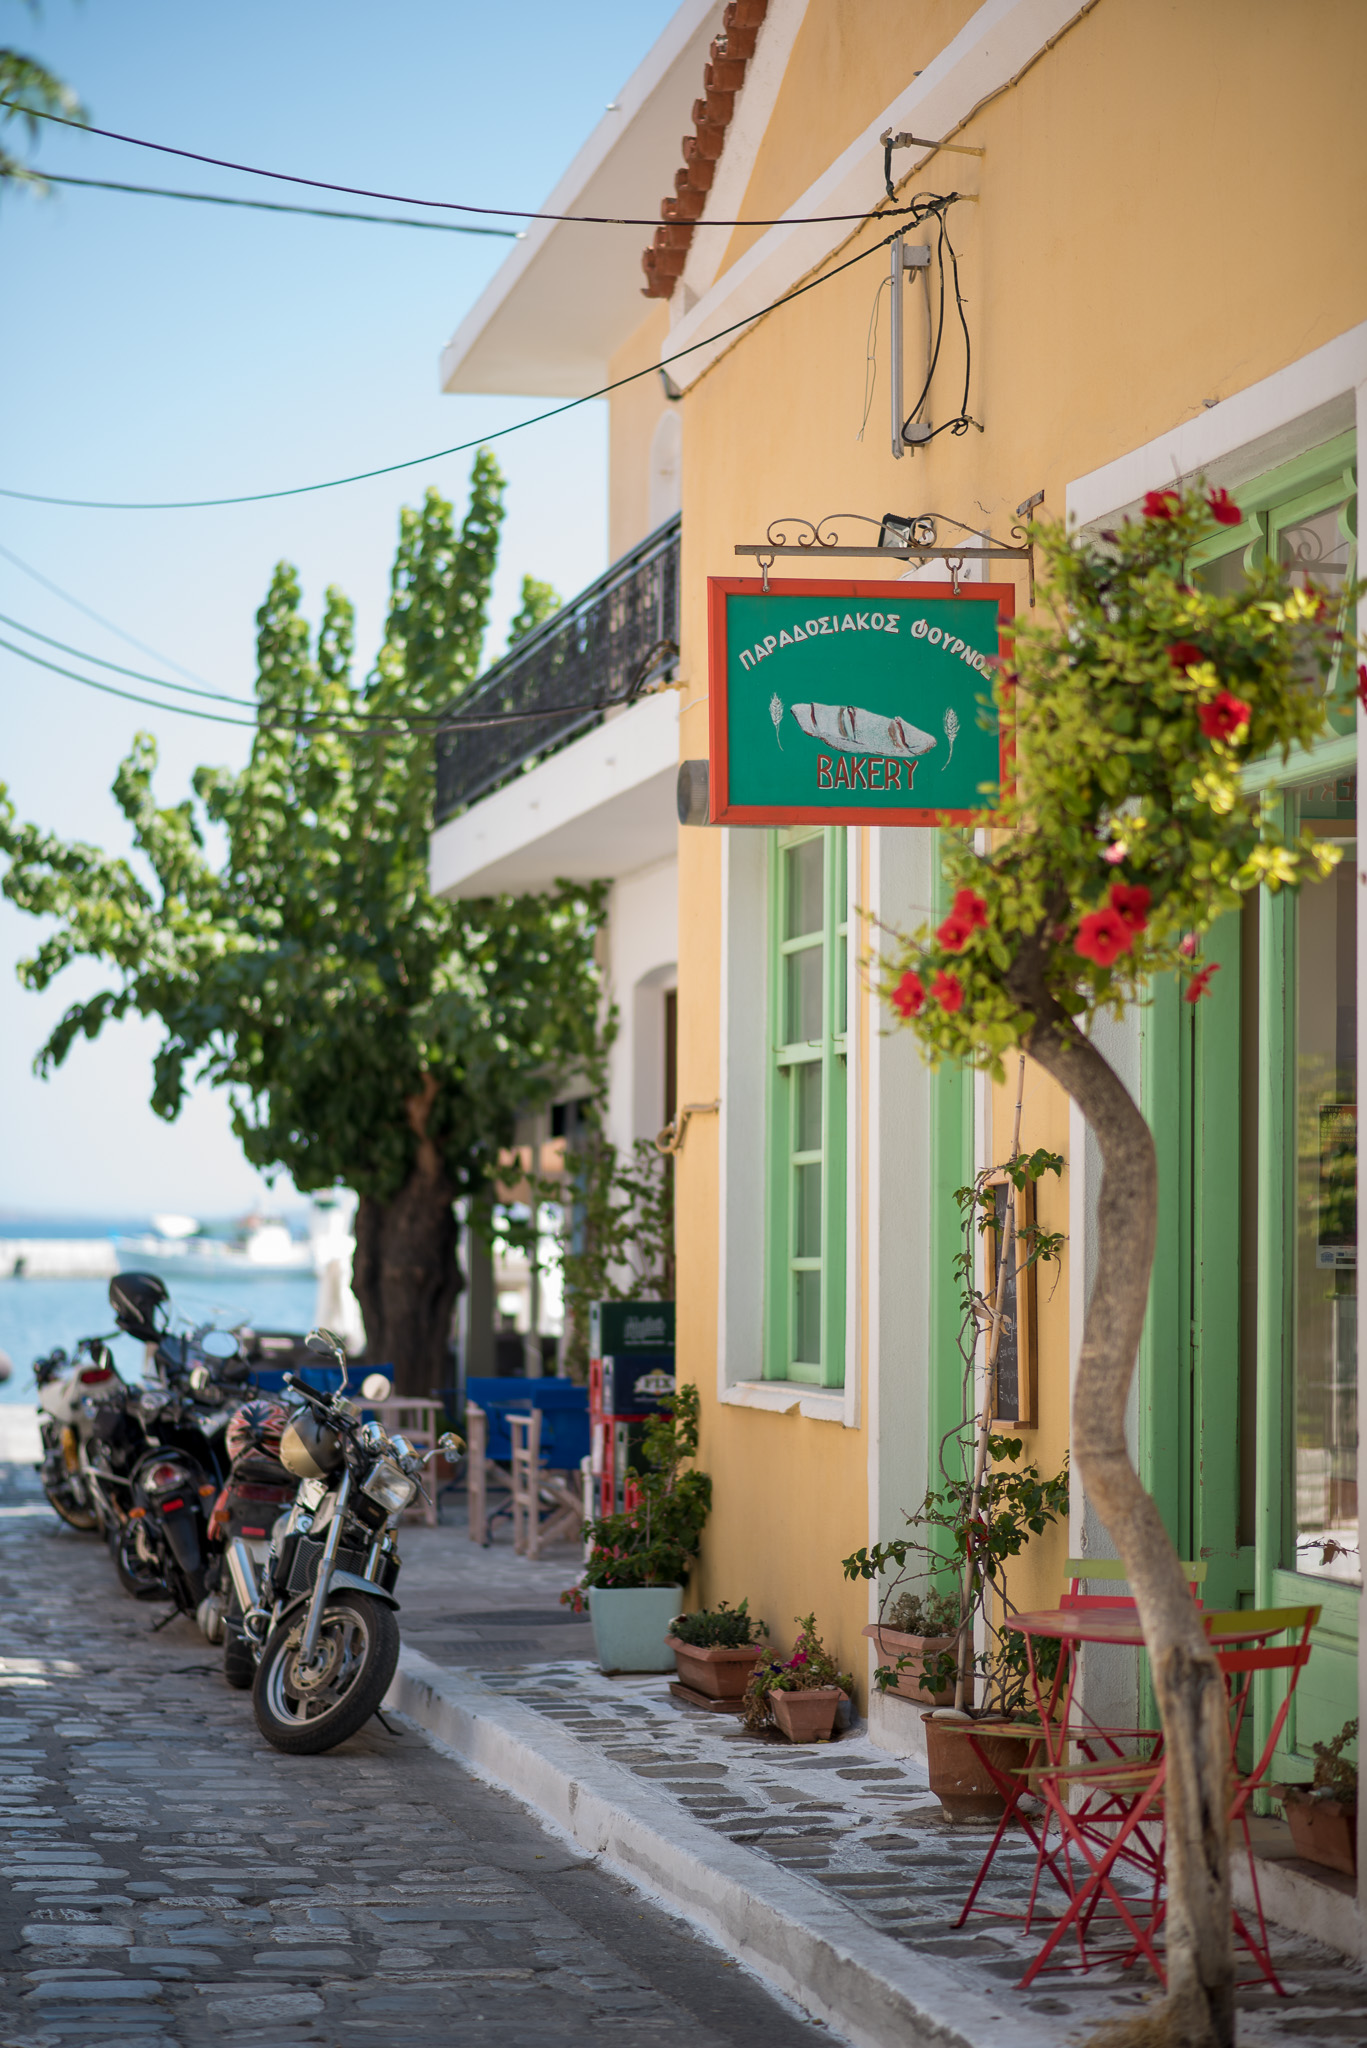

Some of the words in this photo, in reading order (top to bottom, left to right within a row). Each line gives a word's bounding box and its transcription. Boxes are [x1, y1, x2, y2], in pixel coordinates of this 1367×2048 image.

[738, 612, 900, 671] ΠΑΡΑΔΟΣΙΑΚΟΣ
[816, 754, 919, 790] BAKERY
[644, 1377, 673, 1389] FIX
